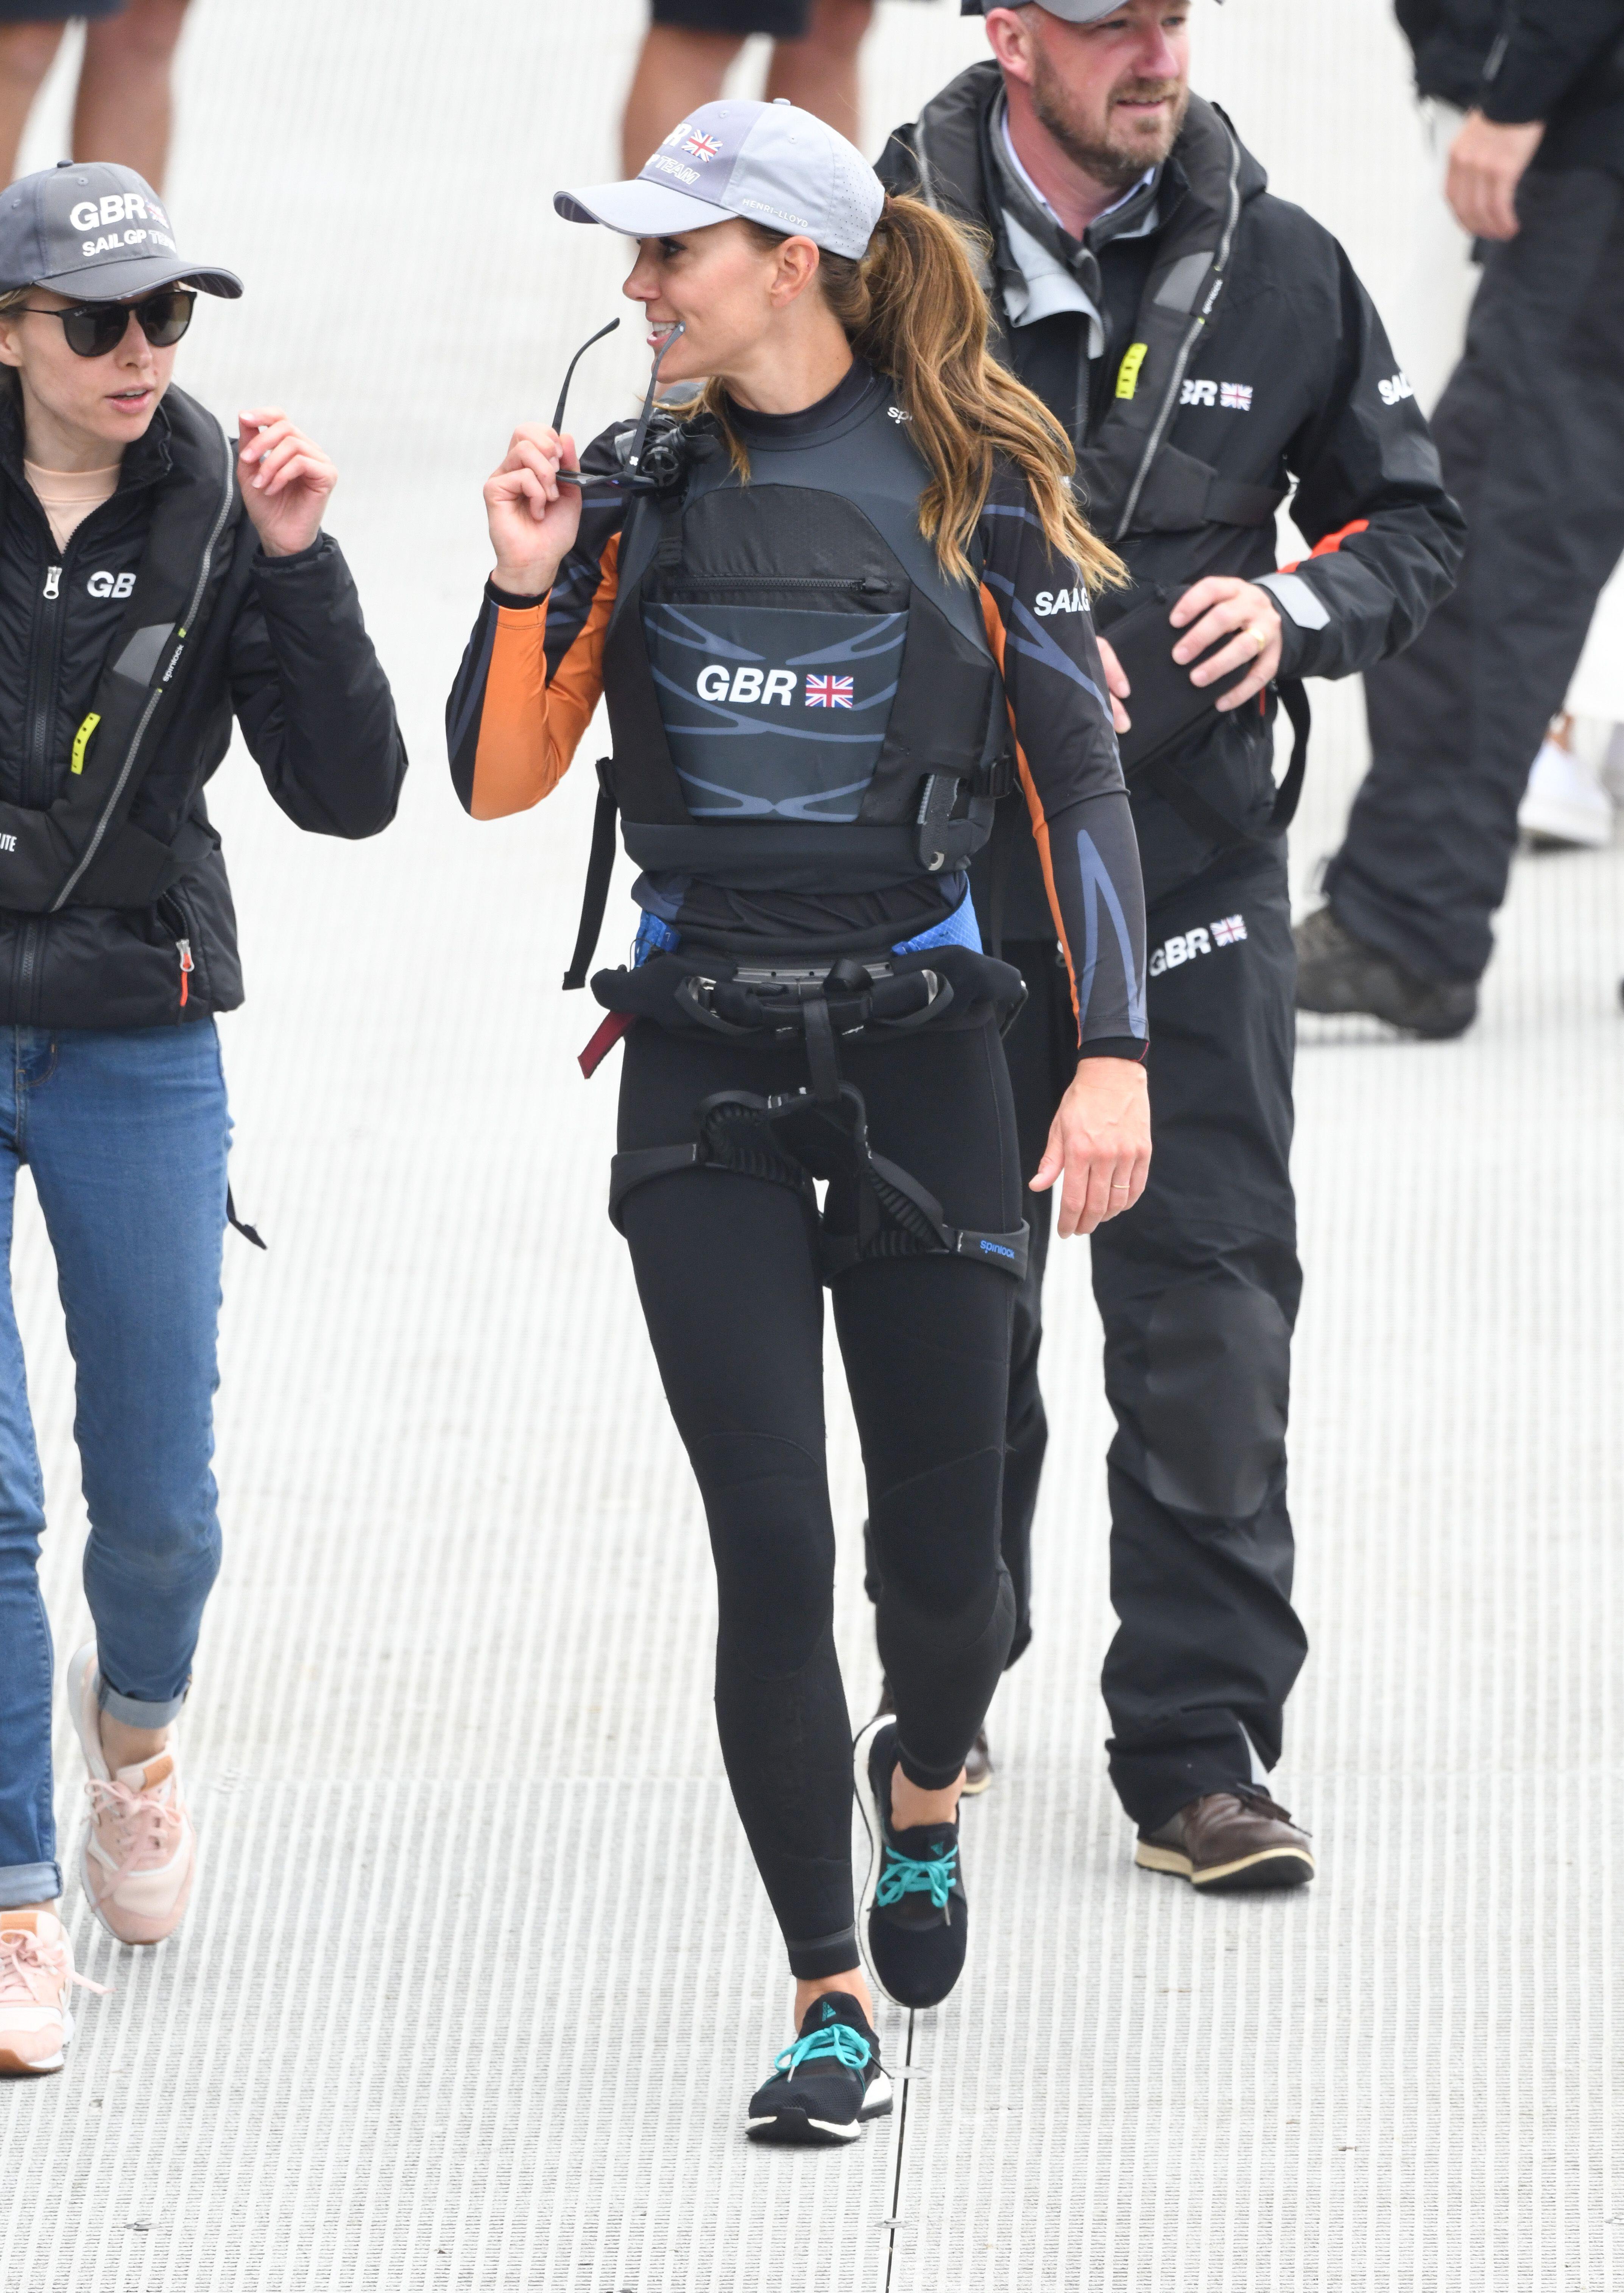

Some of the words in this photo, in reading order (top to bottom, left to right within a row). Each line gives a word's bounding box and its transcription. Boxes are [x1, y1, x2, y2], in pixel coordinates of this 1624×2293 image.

[655, 155, 700, 185] TEAM
[70, 193, 148, 231] GBR
[743, 199, 808, 228] HENRI-LLOYD
[162, 644, 184, 681] spinlock
[697, 665, 797, 706] GBR
[0, 832, 17, 852] ITE
[1149, 927, 1211, 977] GBR
[980, 1240, 1015, 1259] spinlock
